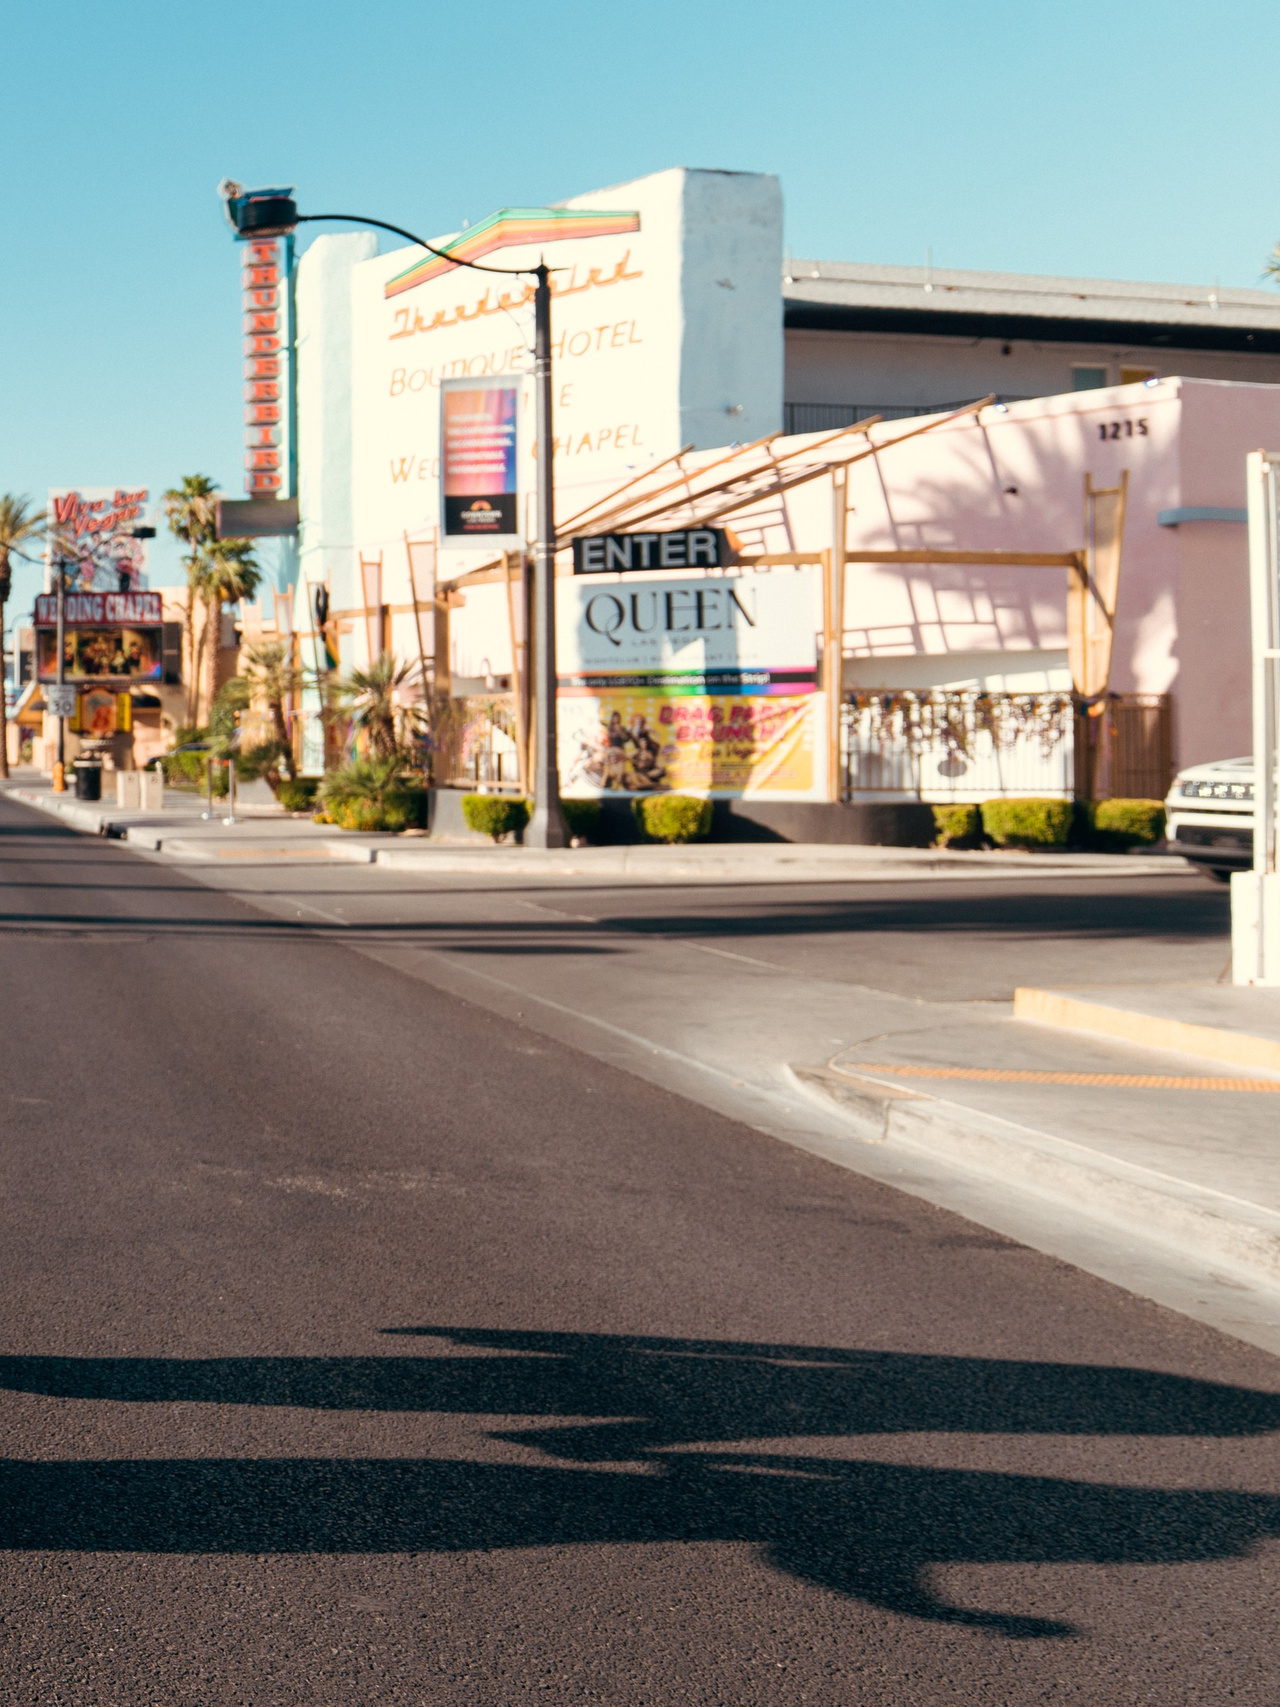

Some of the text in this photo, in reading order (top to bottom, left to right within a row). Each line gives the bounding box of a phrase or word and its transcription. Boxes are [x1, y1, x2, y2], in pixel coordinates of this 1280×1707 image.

[549, 319, 643, 360] HOTEL
[250, 244, 282, 490] THUNDERBIRD
[1098, 418, 1149, 441] 1215
[582, 530, 718, 573] ENTER
[105, 594, 161, 622] CHAPEL
[585, 587, 757, 647] QUEEN
[659, 705, 724, 725] DRAG
